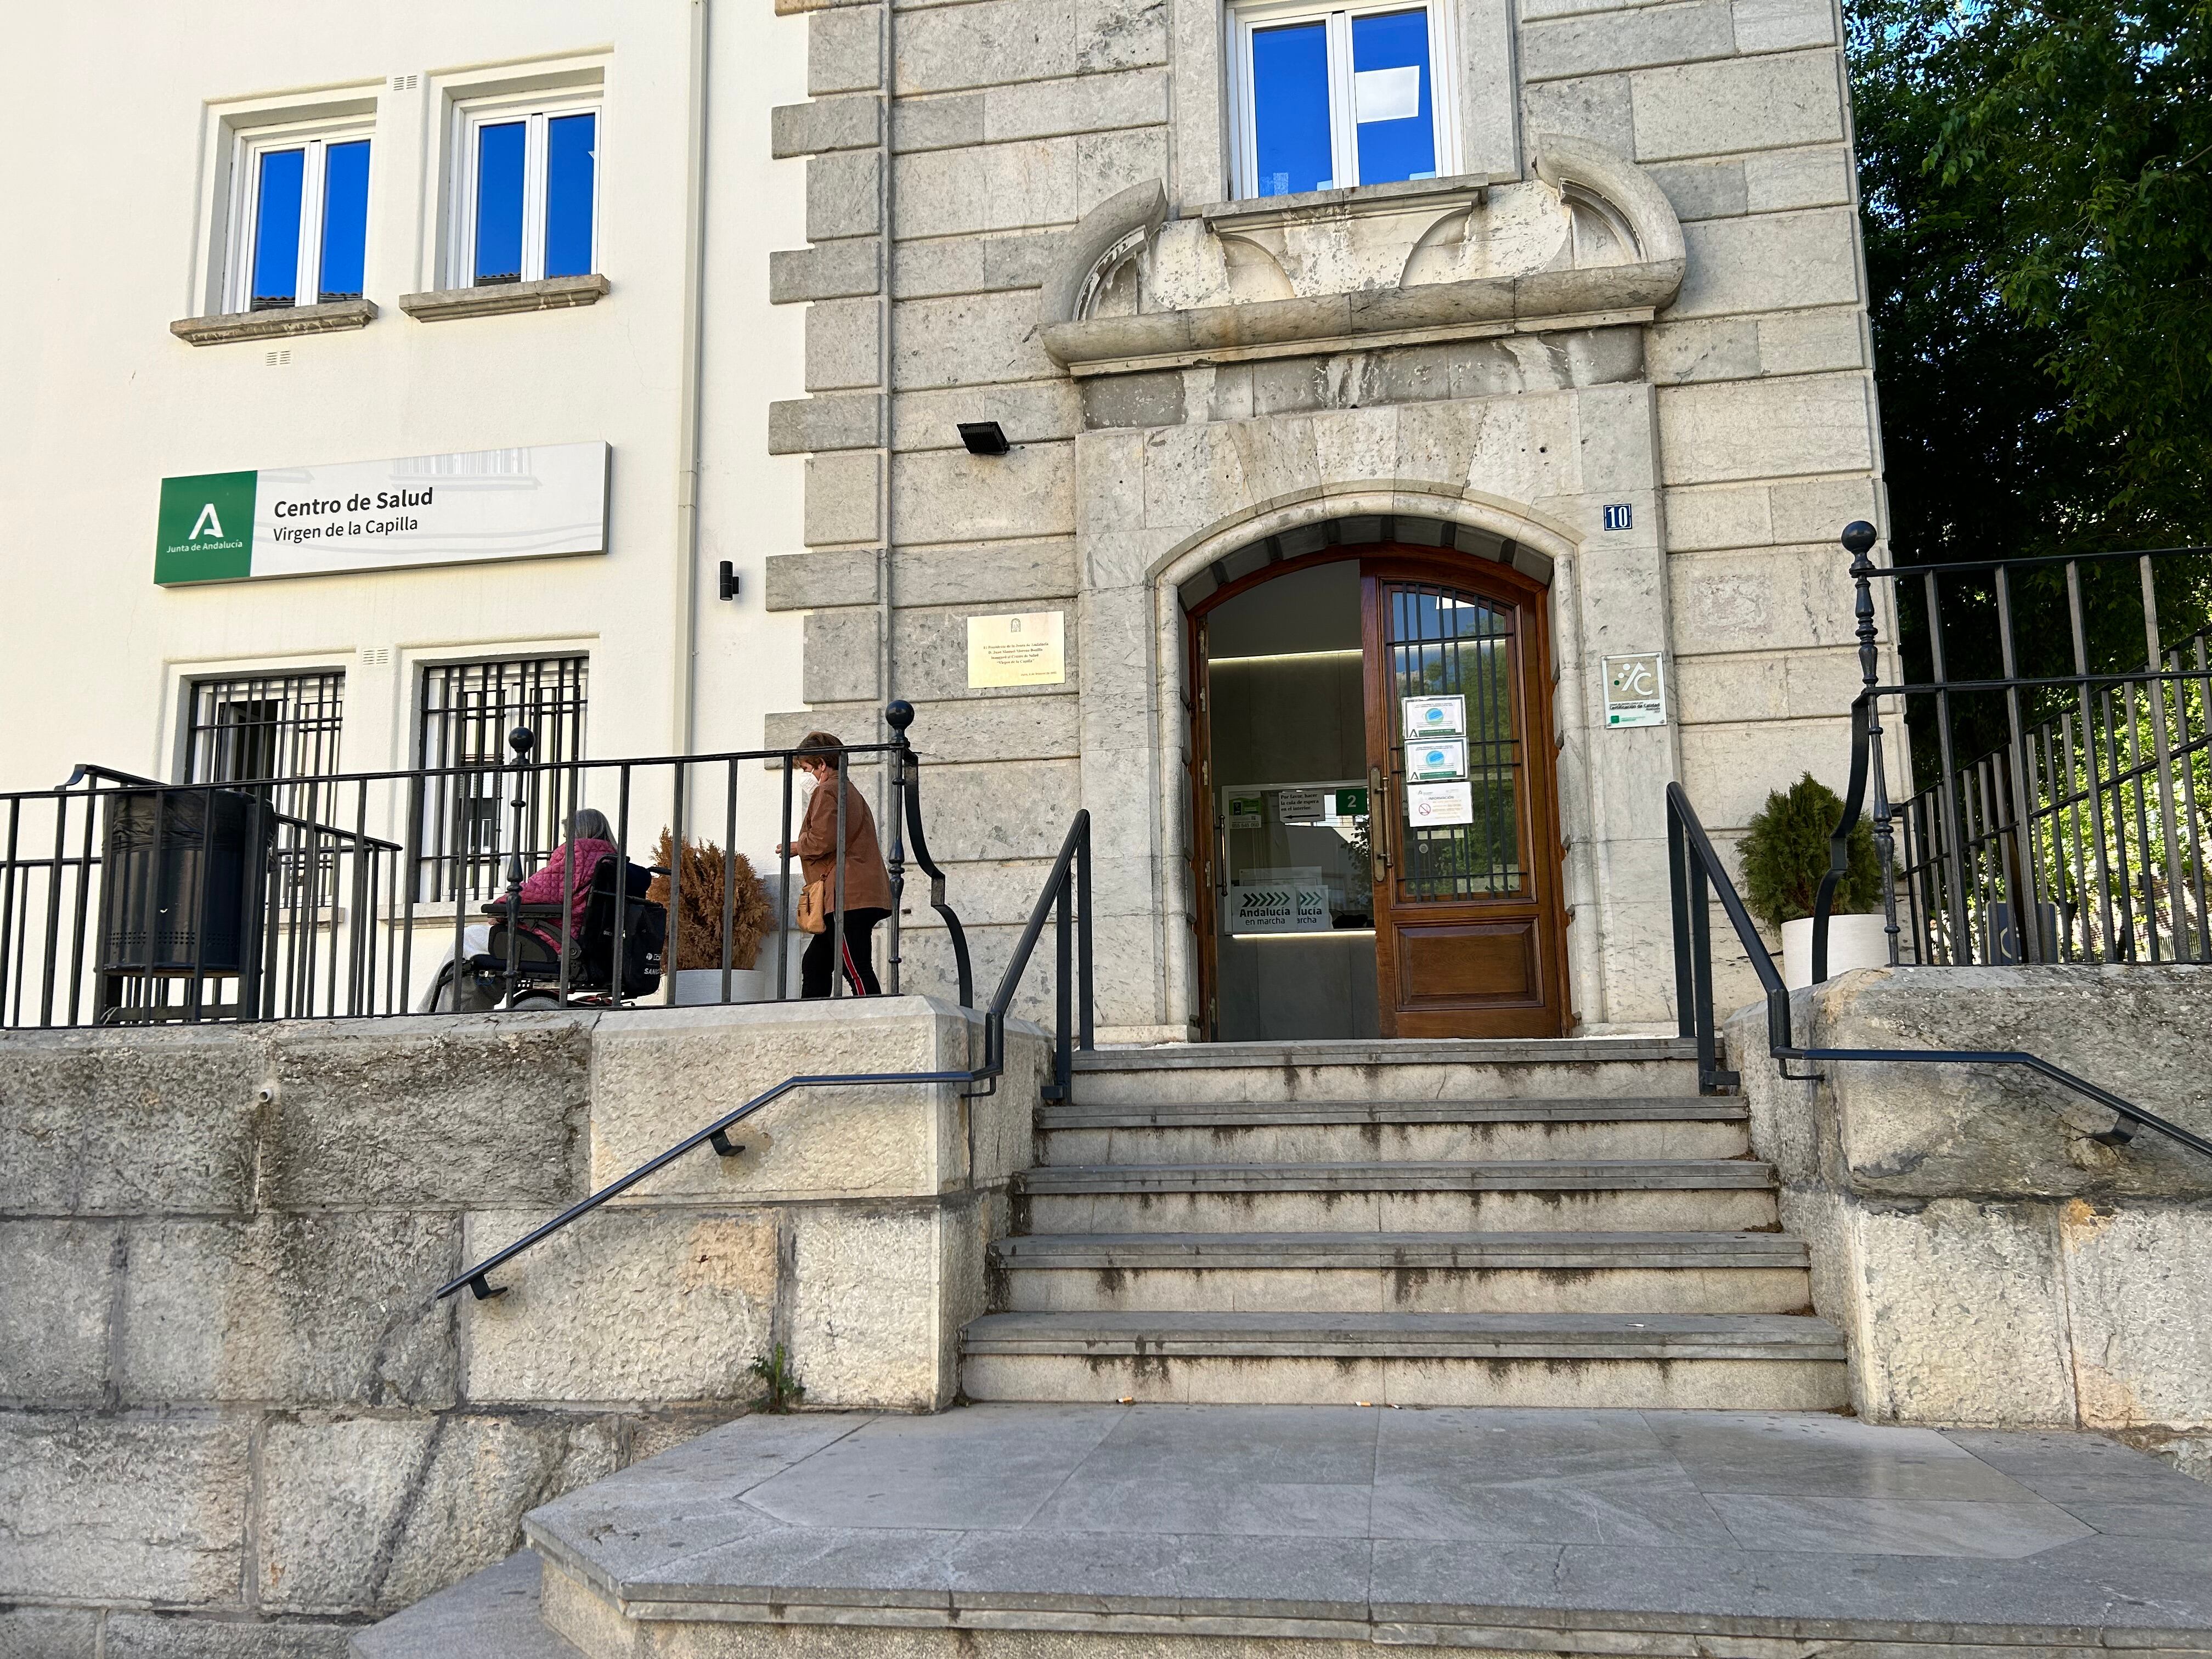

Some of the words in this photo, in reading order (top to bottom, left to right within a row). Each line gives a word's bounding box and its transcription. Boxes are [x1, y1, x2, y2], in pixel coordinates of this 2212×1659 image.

[274, 499, 341, 517] Centro
[347, 494, 371, 512] de
[376, 487, 433, 509] Salud
[1607, 506, 1628, 528] 10
[274, 527, 321, 543] Virgen
[325, 523, 344, 537] de
[348, 521, 361, 535] la
[366, 516, 417, 535] Capilla
[202, 539, 242, 550] Andalucía
[1347, 795, 1356, 808] 2
[1239, 906, 1290, 917] Andalucía
[1257, 916, 1285, 925] marcha
